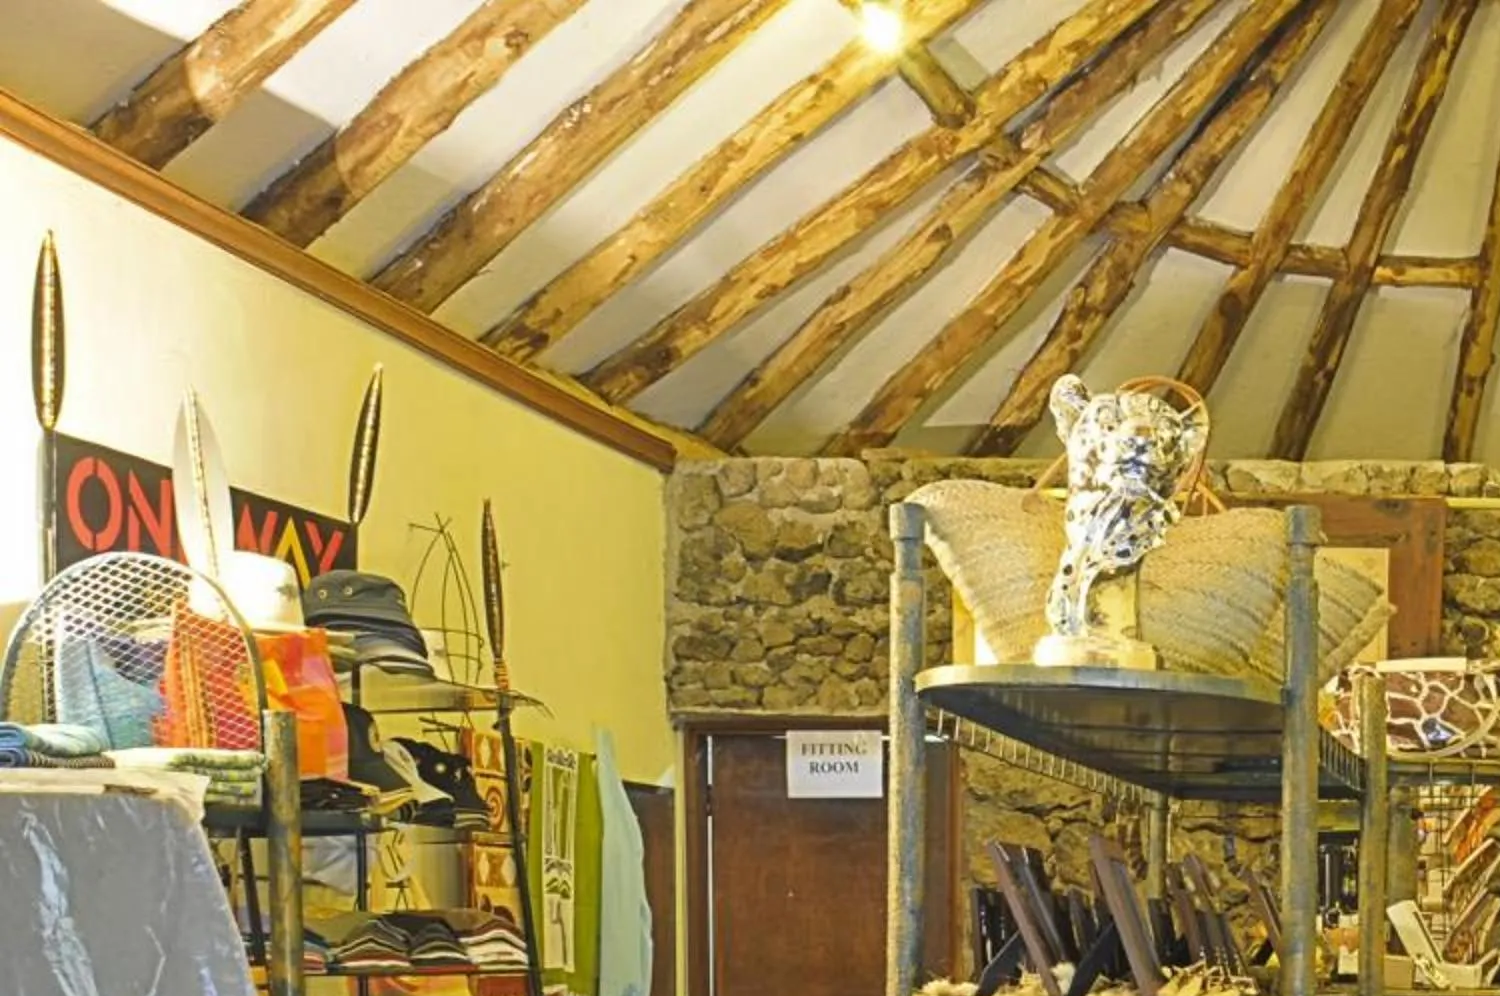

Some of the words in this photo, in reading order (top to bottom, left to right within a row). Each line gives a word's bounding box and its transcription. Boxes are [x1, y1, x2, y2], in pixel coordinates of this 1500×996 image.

[67, 456, 188, 565] ON
[801, 741, 868, 756] FITTING
[809, 761, 860, 774] ROOM
